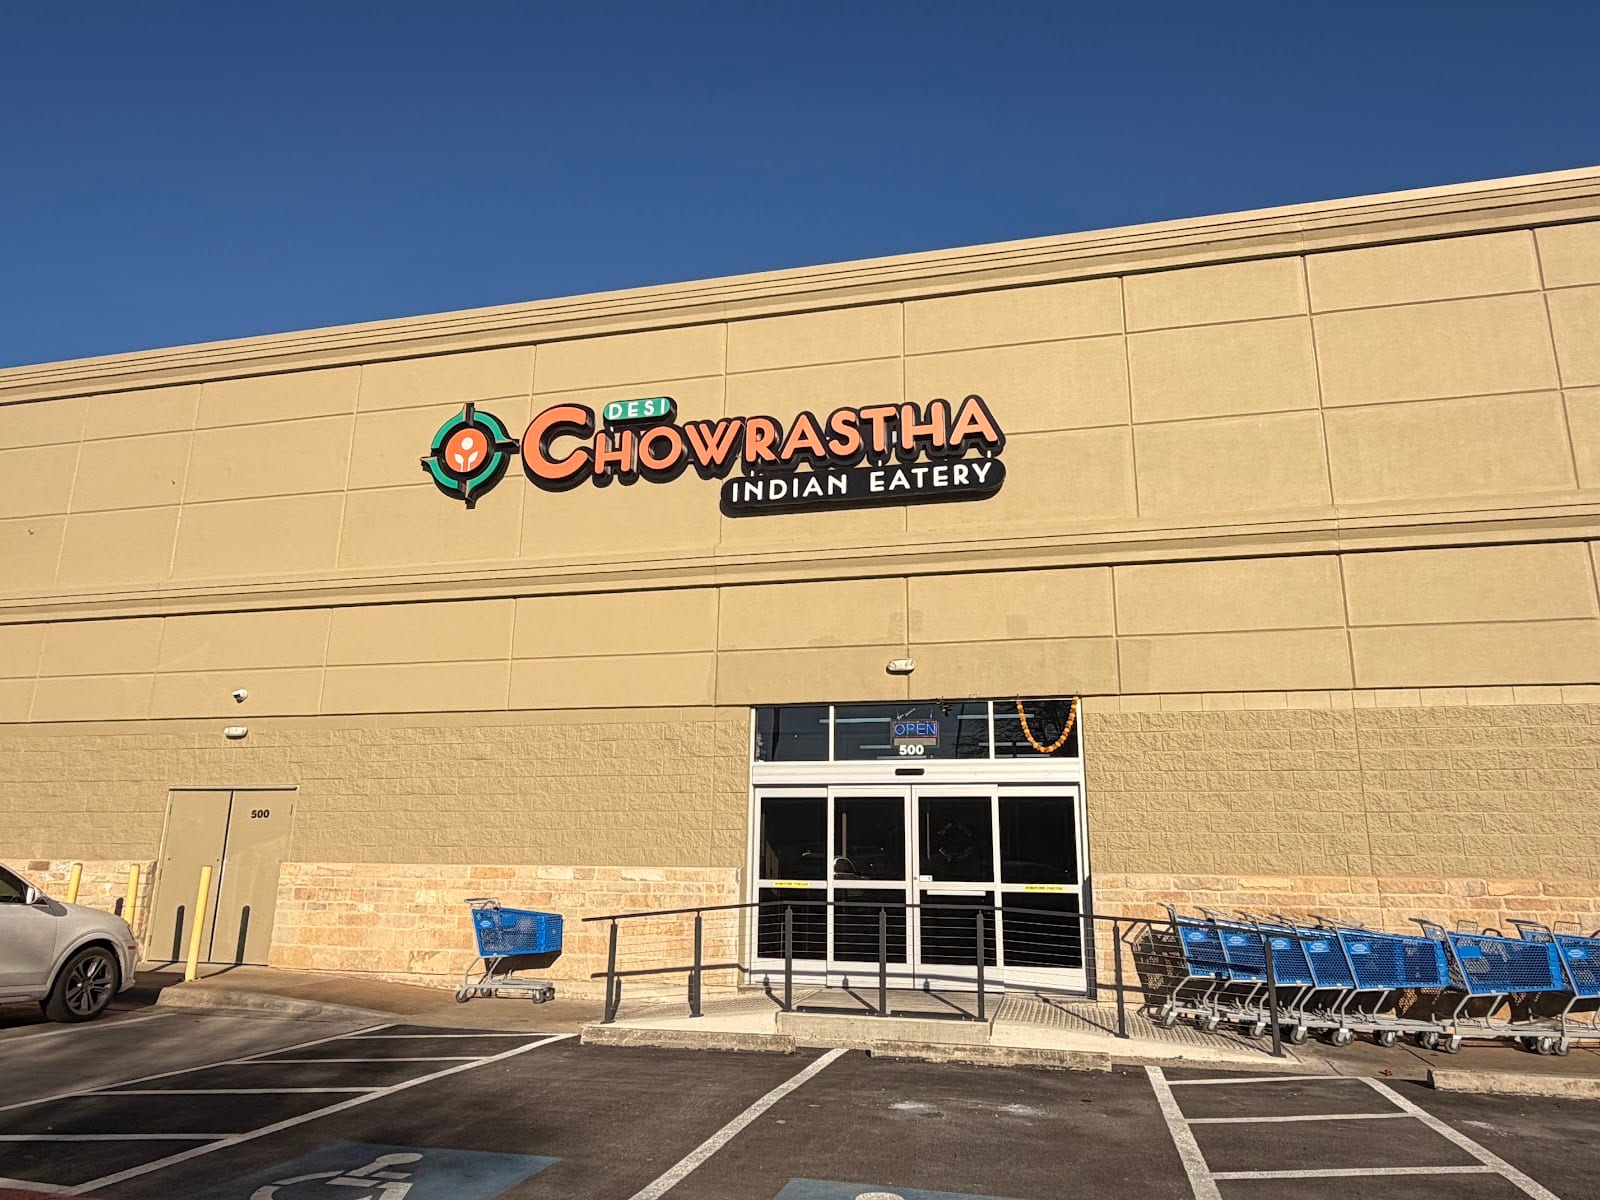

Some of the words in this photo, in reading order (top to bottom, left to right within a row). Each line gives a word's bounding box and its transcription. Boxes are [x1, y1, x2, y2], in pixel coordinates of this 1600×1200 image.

[608, 398, 666, 420] DESI
[523, 399, 998, 479] CHOWRASTHA
[732, 474, 847, 502] INDIAN
[869, 462, 992, 493] EATERY
[895, 723, 936, 735] OPEN
[899, 744, 925, 755] 500
[250, 809, 270, 819] 500
